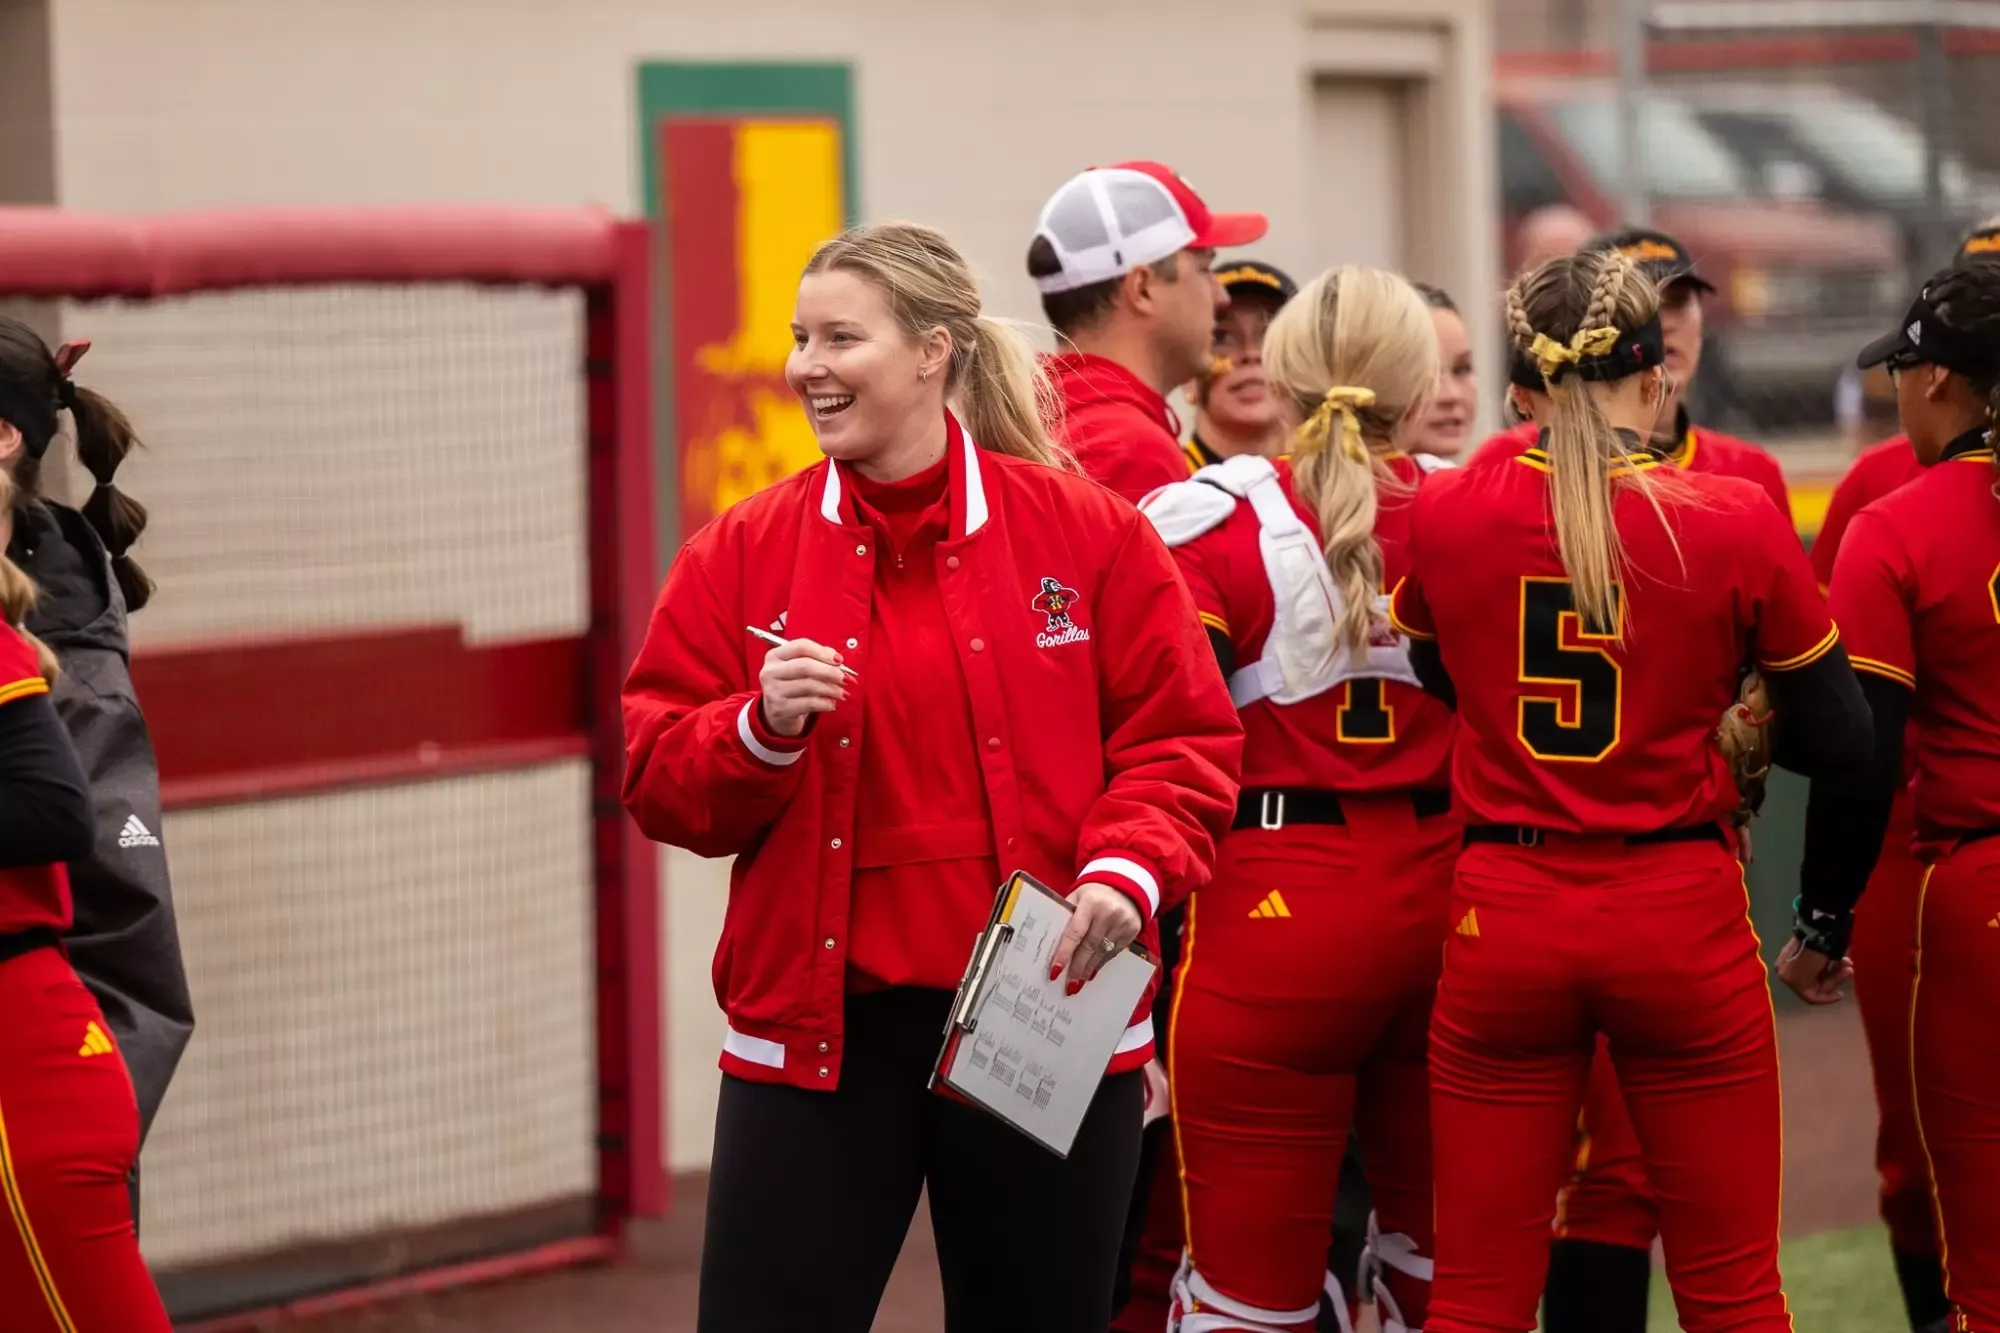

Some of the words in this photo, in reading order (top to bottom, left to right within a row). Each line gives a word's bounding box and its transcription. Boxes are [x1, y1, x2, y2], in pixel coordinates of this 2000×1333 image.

[1036, 626, 1090, 648] Gorillas
[1517, 575, 1624, 763] 5
[118, 835, 160, 848] adidas
